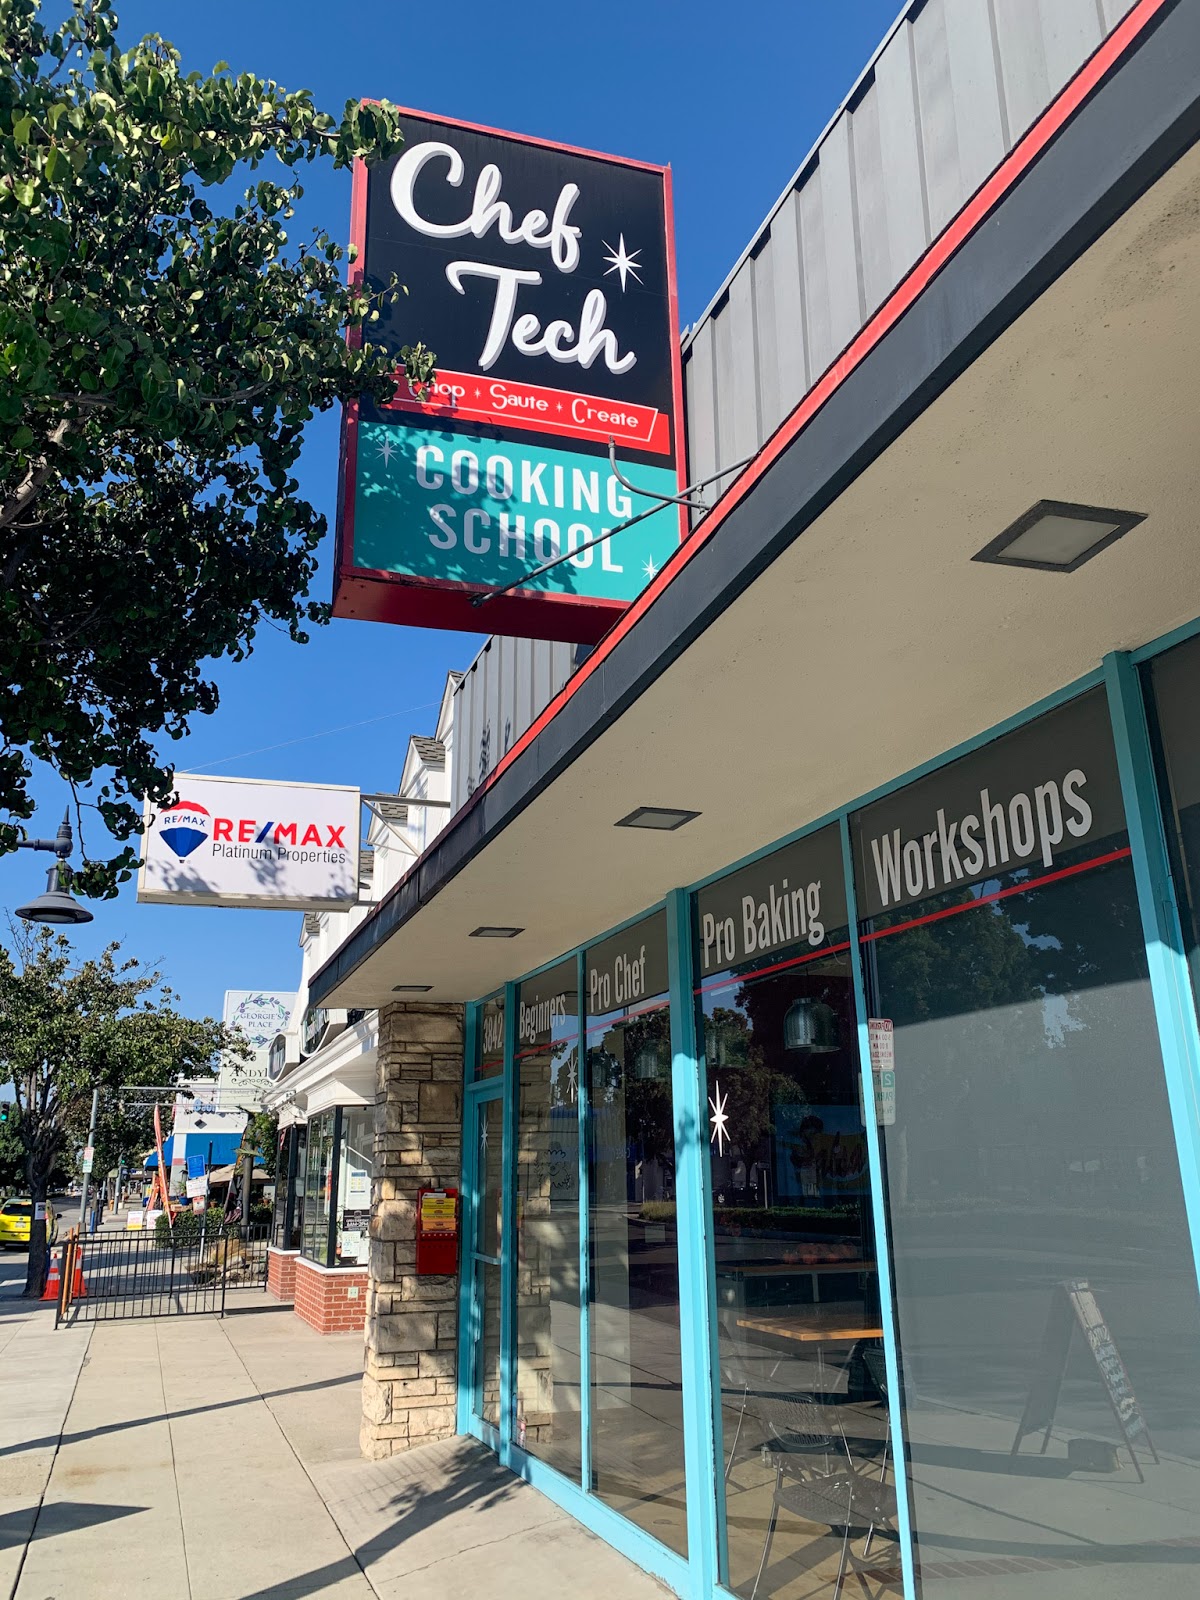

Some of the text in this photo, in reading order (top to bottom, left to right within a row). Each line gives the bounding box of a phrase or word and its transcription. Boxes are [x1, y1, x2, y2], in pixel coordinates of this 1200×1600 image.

[389, 141, 582, 273] Chef
[445, 260, 637, 374] Tech
[489, 383, 549, 411] Saute
[571, 398, 639, 428] Create
[416, 445, 633, 519] COOKING
[428, 503, 624, 573] SCHOOL
[164, 815, 206, 827] RE/MAX
[213, 818, 346, 848] RE/MAX
[871, 769, 1093, 906] Workshops
[212, 843, 346, 864] Platinum Properties
[703, 878, 825, 969] Pro Baking
[590, 945, 646, 1013] Pro Chef
[240, 1012, 282, 1020] GEORGIE'S
[483, 1011, 503, 1054] 3842
[519, 993, 566, 1044] Beginners
